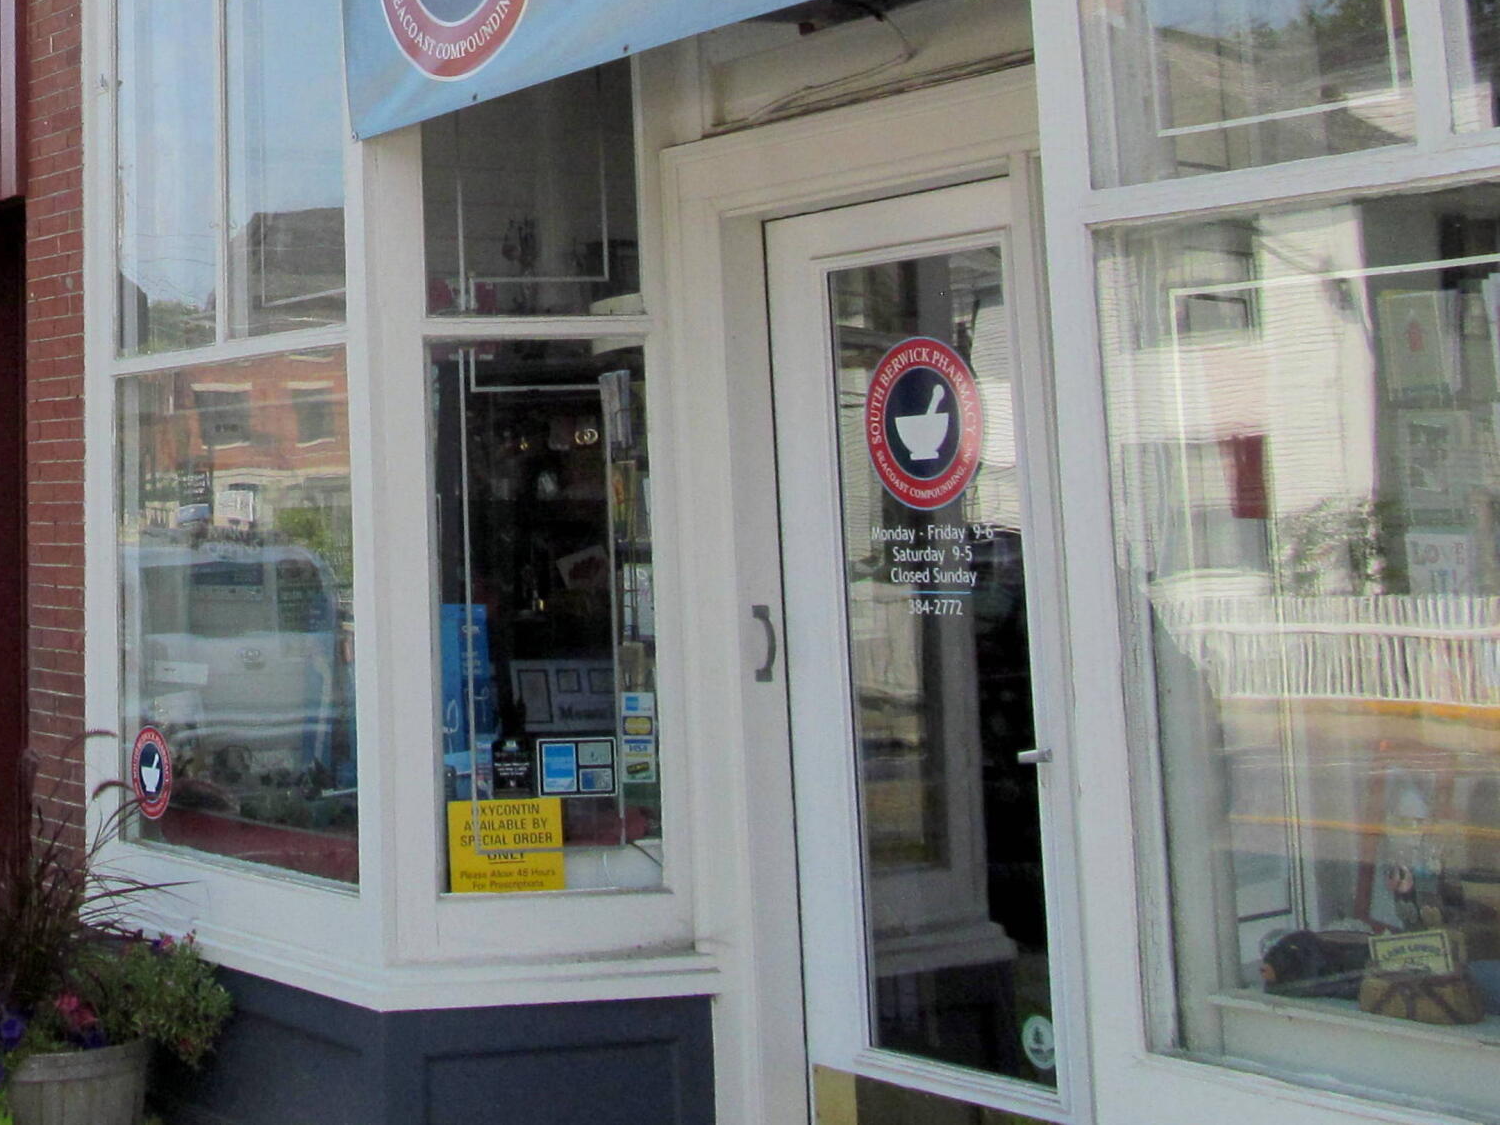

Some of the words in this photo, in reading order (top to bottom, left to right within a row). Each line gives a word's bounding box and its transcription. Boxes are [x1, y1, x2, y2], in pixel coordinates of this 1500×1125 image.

[870, 389, 885, 444] SOUTH
[880, 347, 930, 388] BERWICK
[932, 350, 977, 438] PHARMACY
[876, 450, 909, 493] SEACOAST
[871, 527, 915, 542] Monday
[927, 525, 965, 542] Friday
[973, 525, 994, 539] 9-6
[893, 546, 945, 564] Saturday
[952, 546, 973, 561] 9-5
[891, 567, 930, 583] Closed
[933, 567, 977, 586] Sunday
[908, 599, 963, 615] 384-2772
[532, 818, 548, 830] BY
[460, 834, 508, 846] SPCIAL
[514, 832, 553, 844] ORDER
